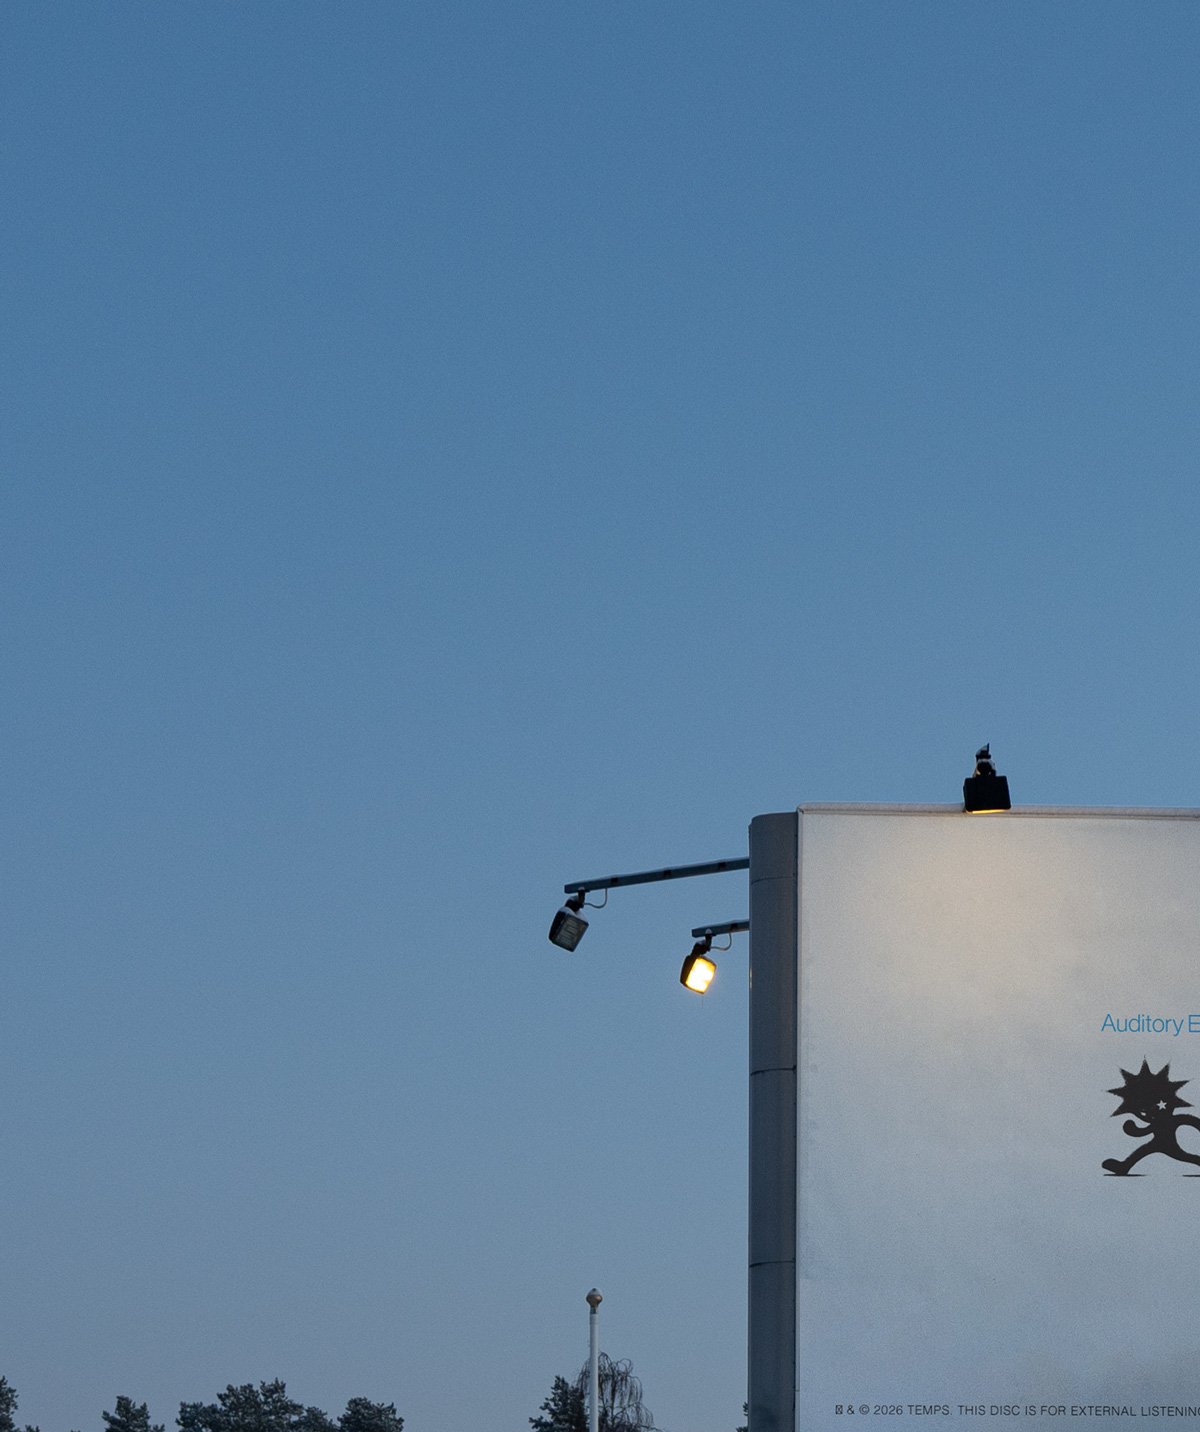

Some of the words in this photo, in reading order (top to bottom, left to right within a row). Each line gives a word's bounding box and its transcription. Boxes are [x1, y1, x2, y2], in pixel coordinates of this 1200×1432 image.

[1101, 1013, 1184, 1037] Auditory
[846, 1404, 855, 1415] &
[873, 1405, 903, 1415] 2026
[907, 1405, 953, 1416] TEMPS.
[957, 1405, 986, 1416] THIS
[990, 1405, 1021, 1416] DISC
[1025, 1405, 1037, 1416] IS
[1040, 1405, 1067, 1416] FOR
[1071, 1405, 1137, 1416] EXTERNAL
